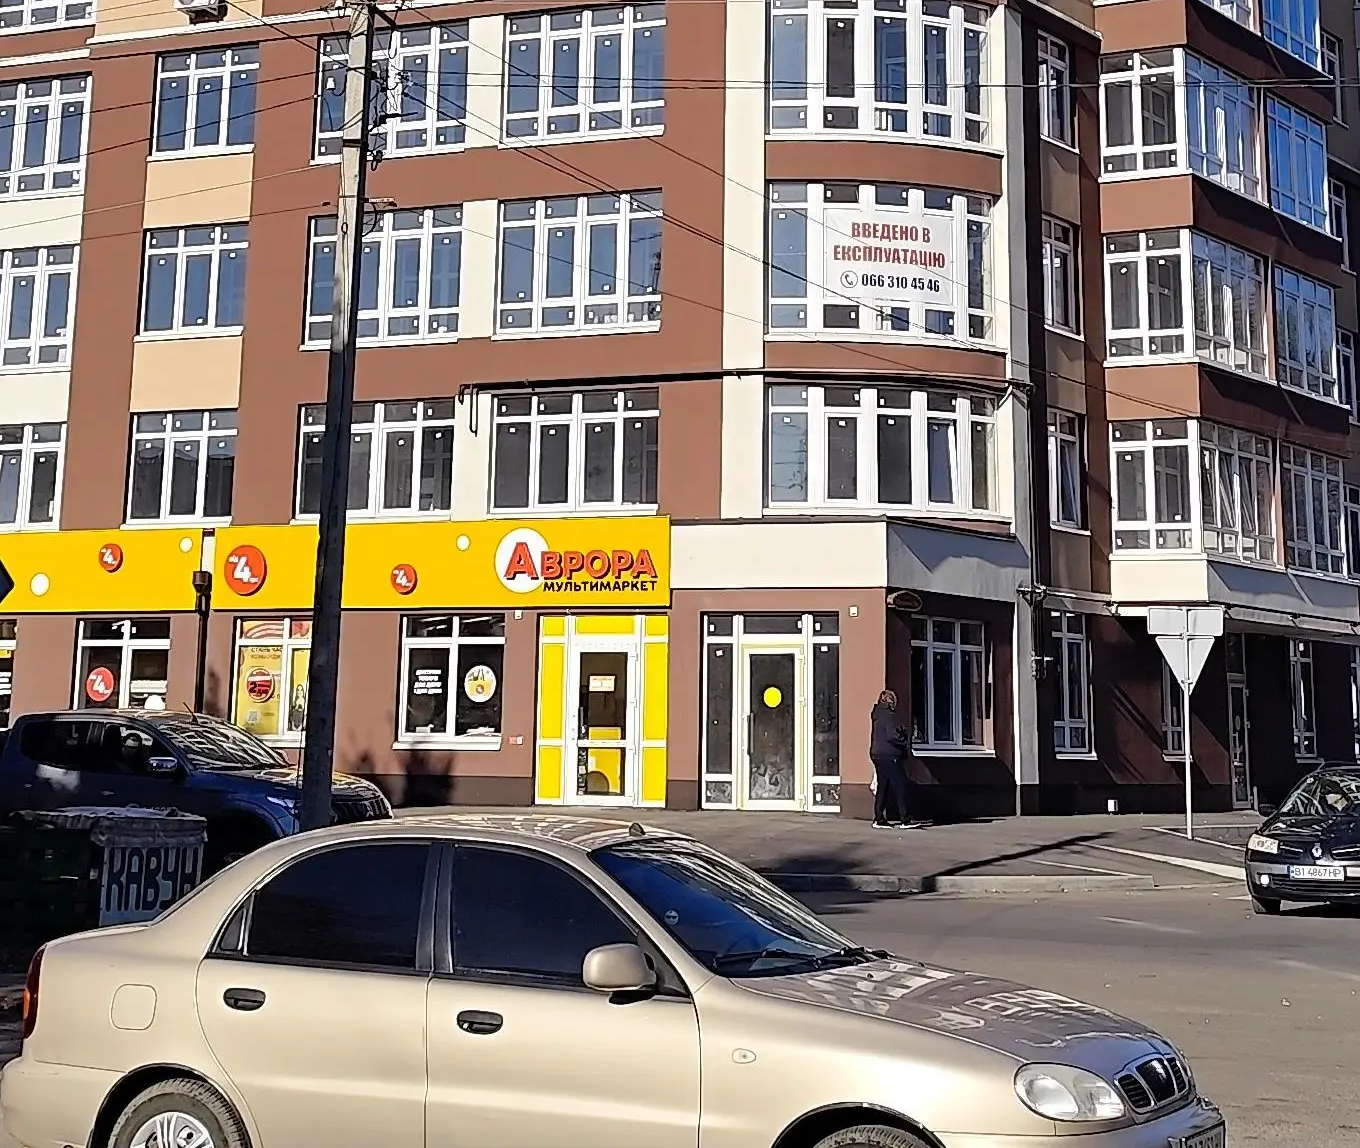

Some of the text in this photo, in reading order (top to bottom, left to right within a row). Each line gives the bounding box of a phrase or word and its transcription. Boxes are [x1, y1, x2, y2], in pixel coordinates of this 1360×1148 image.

[851, 222, 931, 243] ВВЕДЕНО В
[833, 245, 945, 269] ЕКСПЛУАТАЦІЮ
[861, 273, 940, 292] 066 310 45 46
[234, 555, 252, 582] 4
[504, 542, 658, 580] АВРОРА
[543, 580, 658, 592] МУЛЬТИМАРКЕТ
[106, 846, 199, 911] КАВУН
